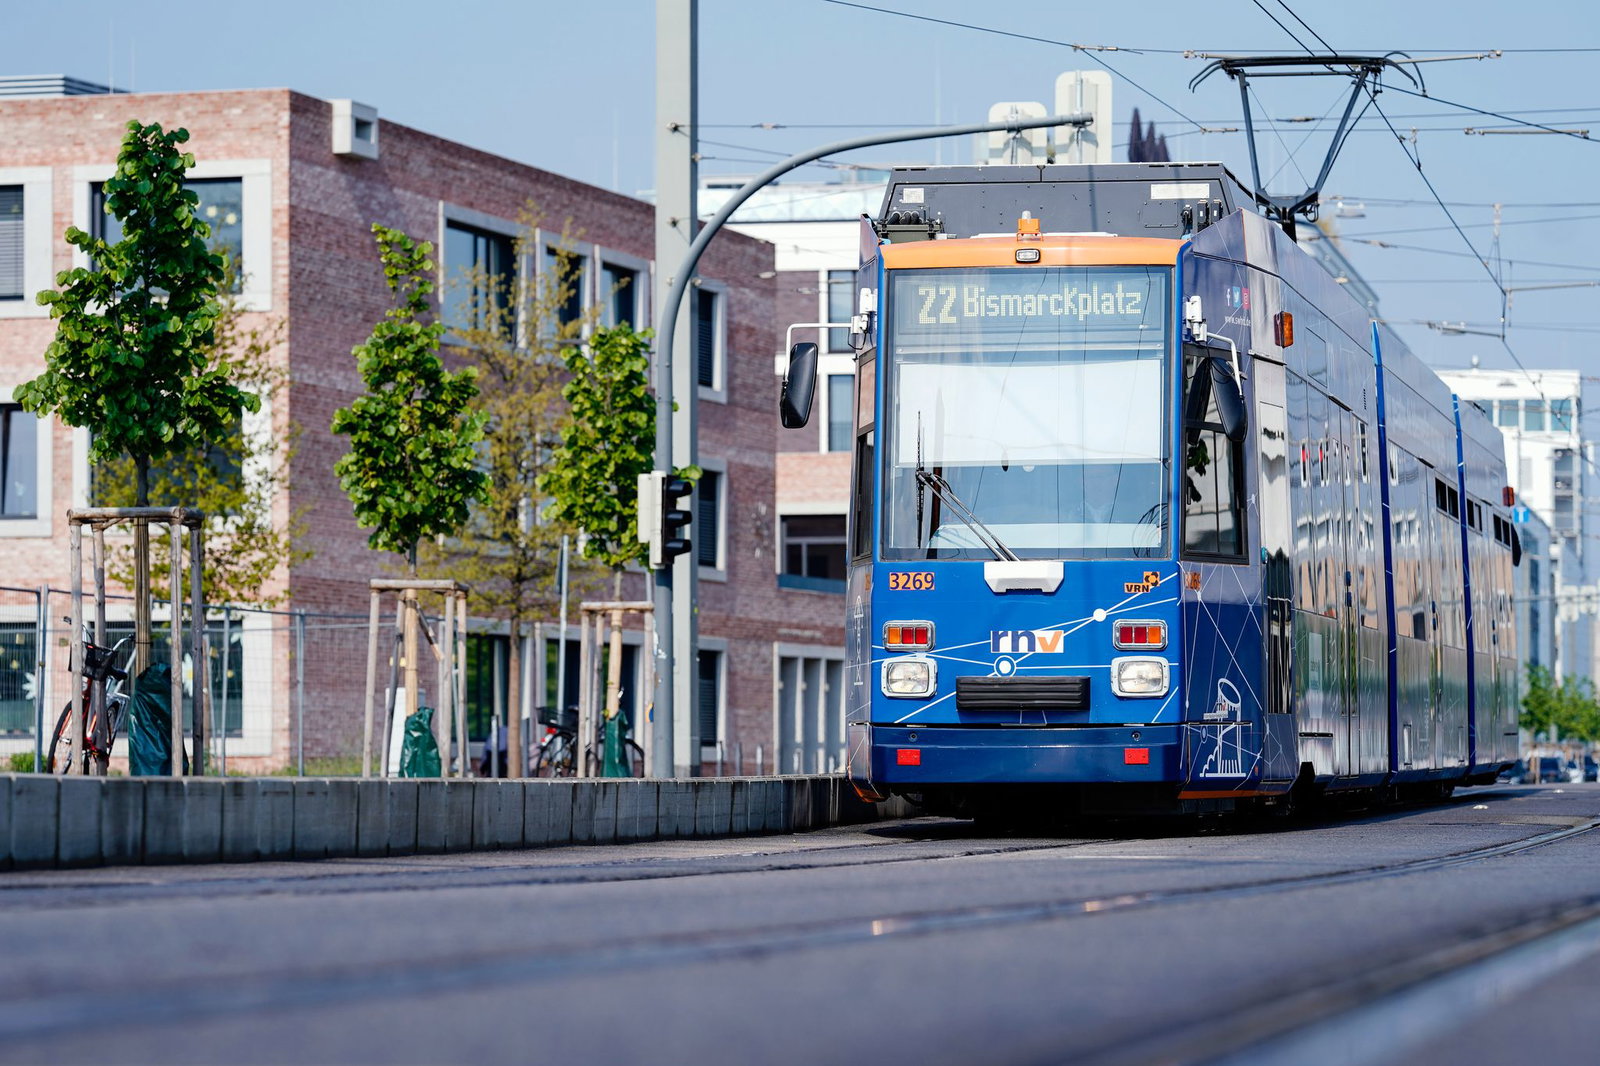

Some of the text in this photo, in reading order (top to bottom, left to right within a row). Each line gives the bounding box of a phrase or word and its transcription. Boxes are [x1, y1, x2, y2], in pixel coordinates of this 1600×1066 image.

[918, 282, 1142, 325] 22 Bismarckplatz
[890, 572, 934, 590] 3269
[1125, 584, 1150, 593] VRN
[991, 630, 1063, 653] rnv
